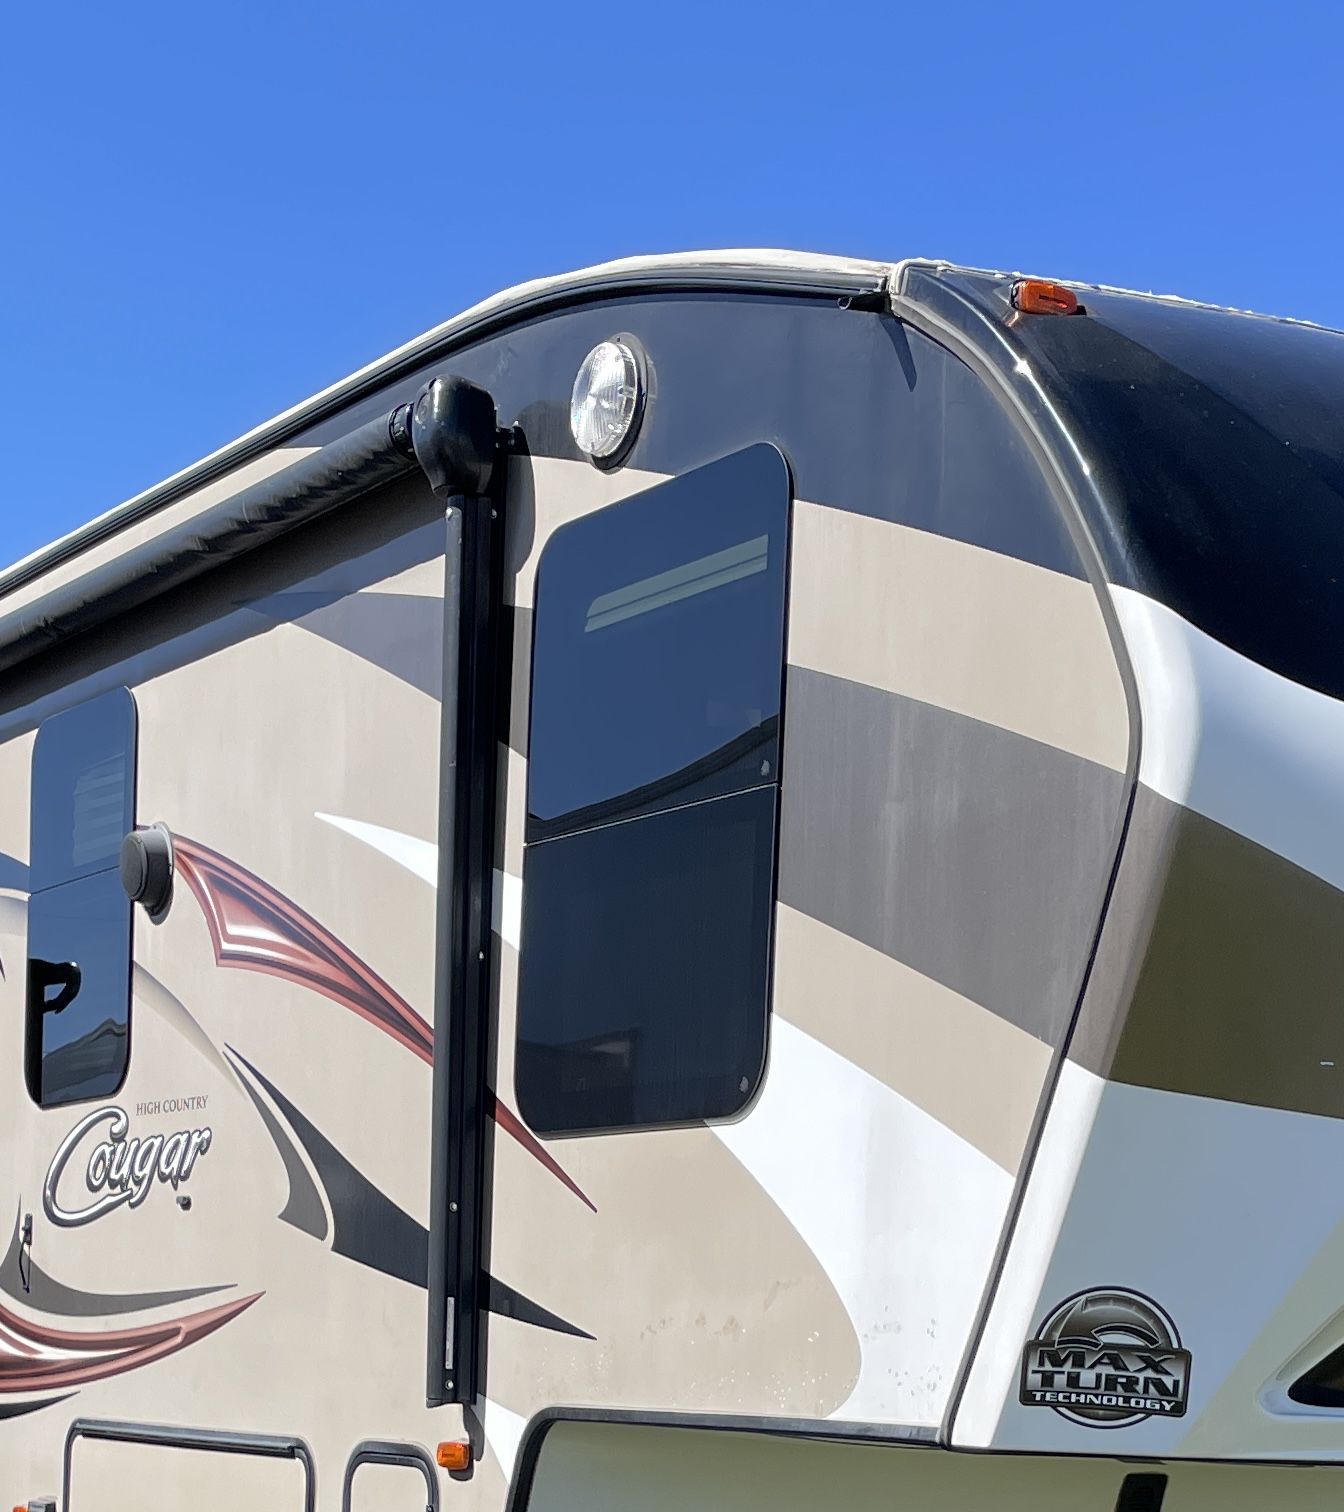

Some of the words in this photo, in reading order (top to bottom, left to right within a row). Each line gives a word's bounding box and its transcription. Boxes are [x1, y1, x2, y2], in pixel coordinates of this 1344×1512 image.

[136, 1101, 160, 1116] HIGH
[162, 1095, 209, 1113] COUNTRY
[43, 1105, 212, 1228] Cougar
[1037, 1347, 1176, 1376] MAX
[1031, 1369, 1181, 1398] TURN
[1031, 1391, 1176, 1411] TECHNOLOGY
